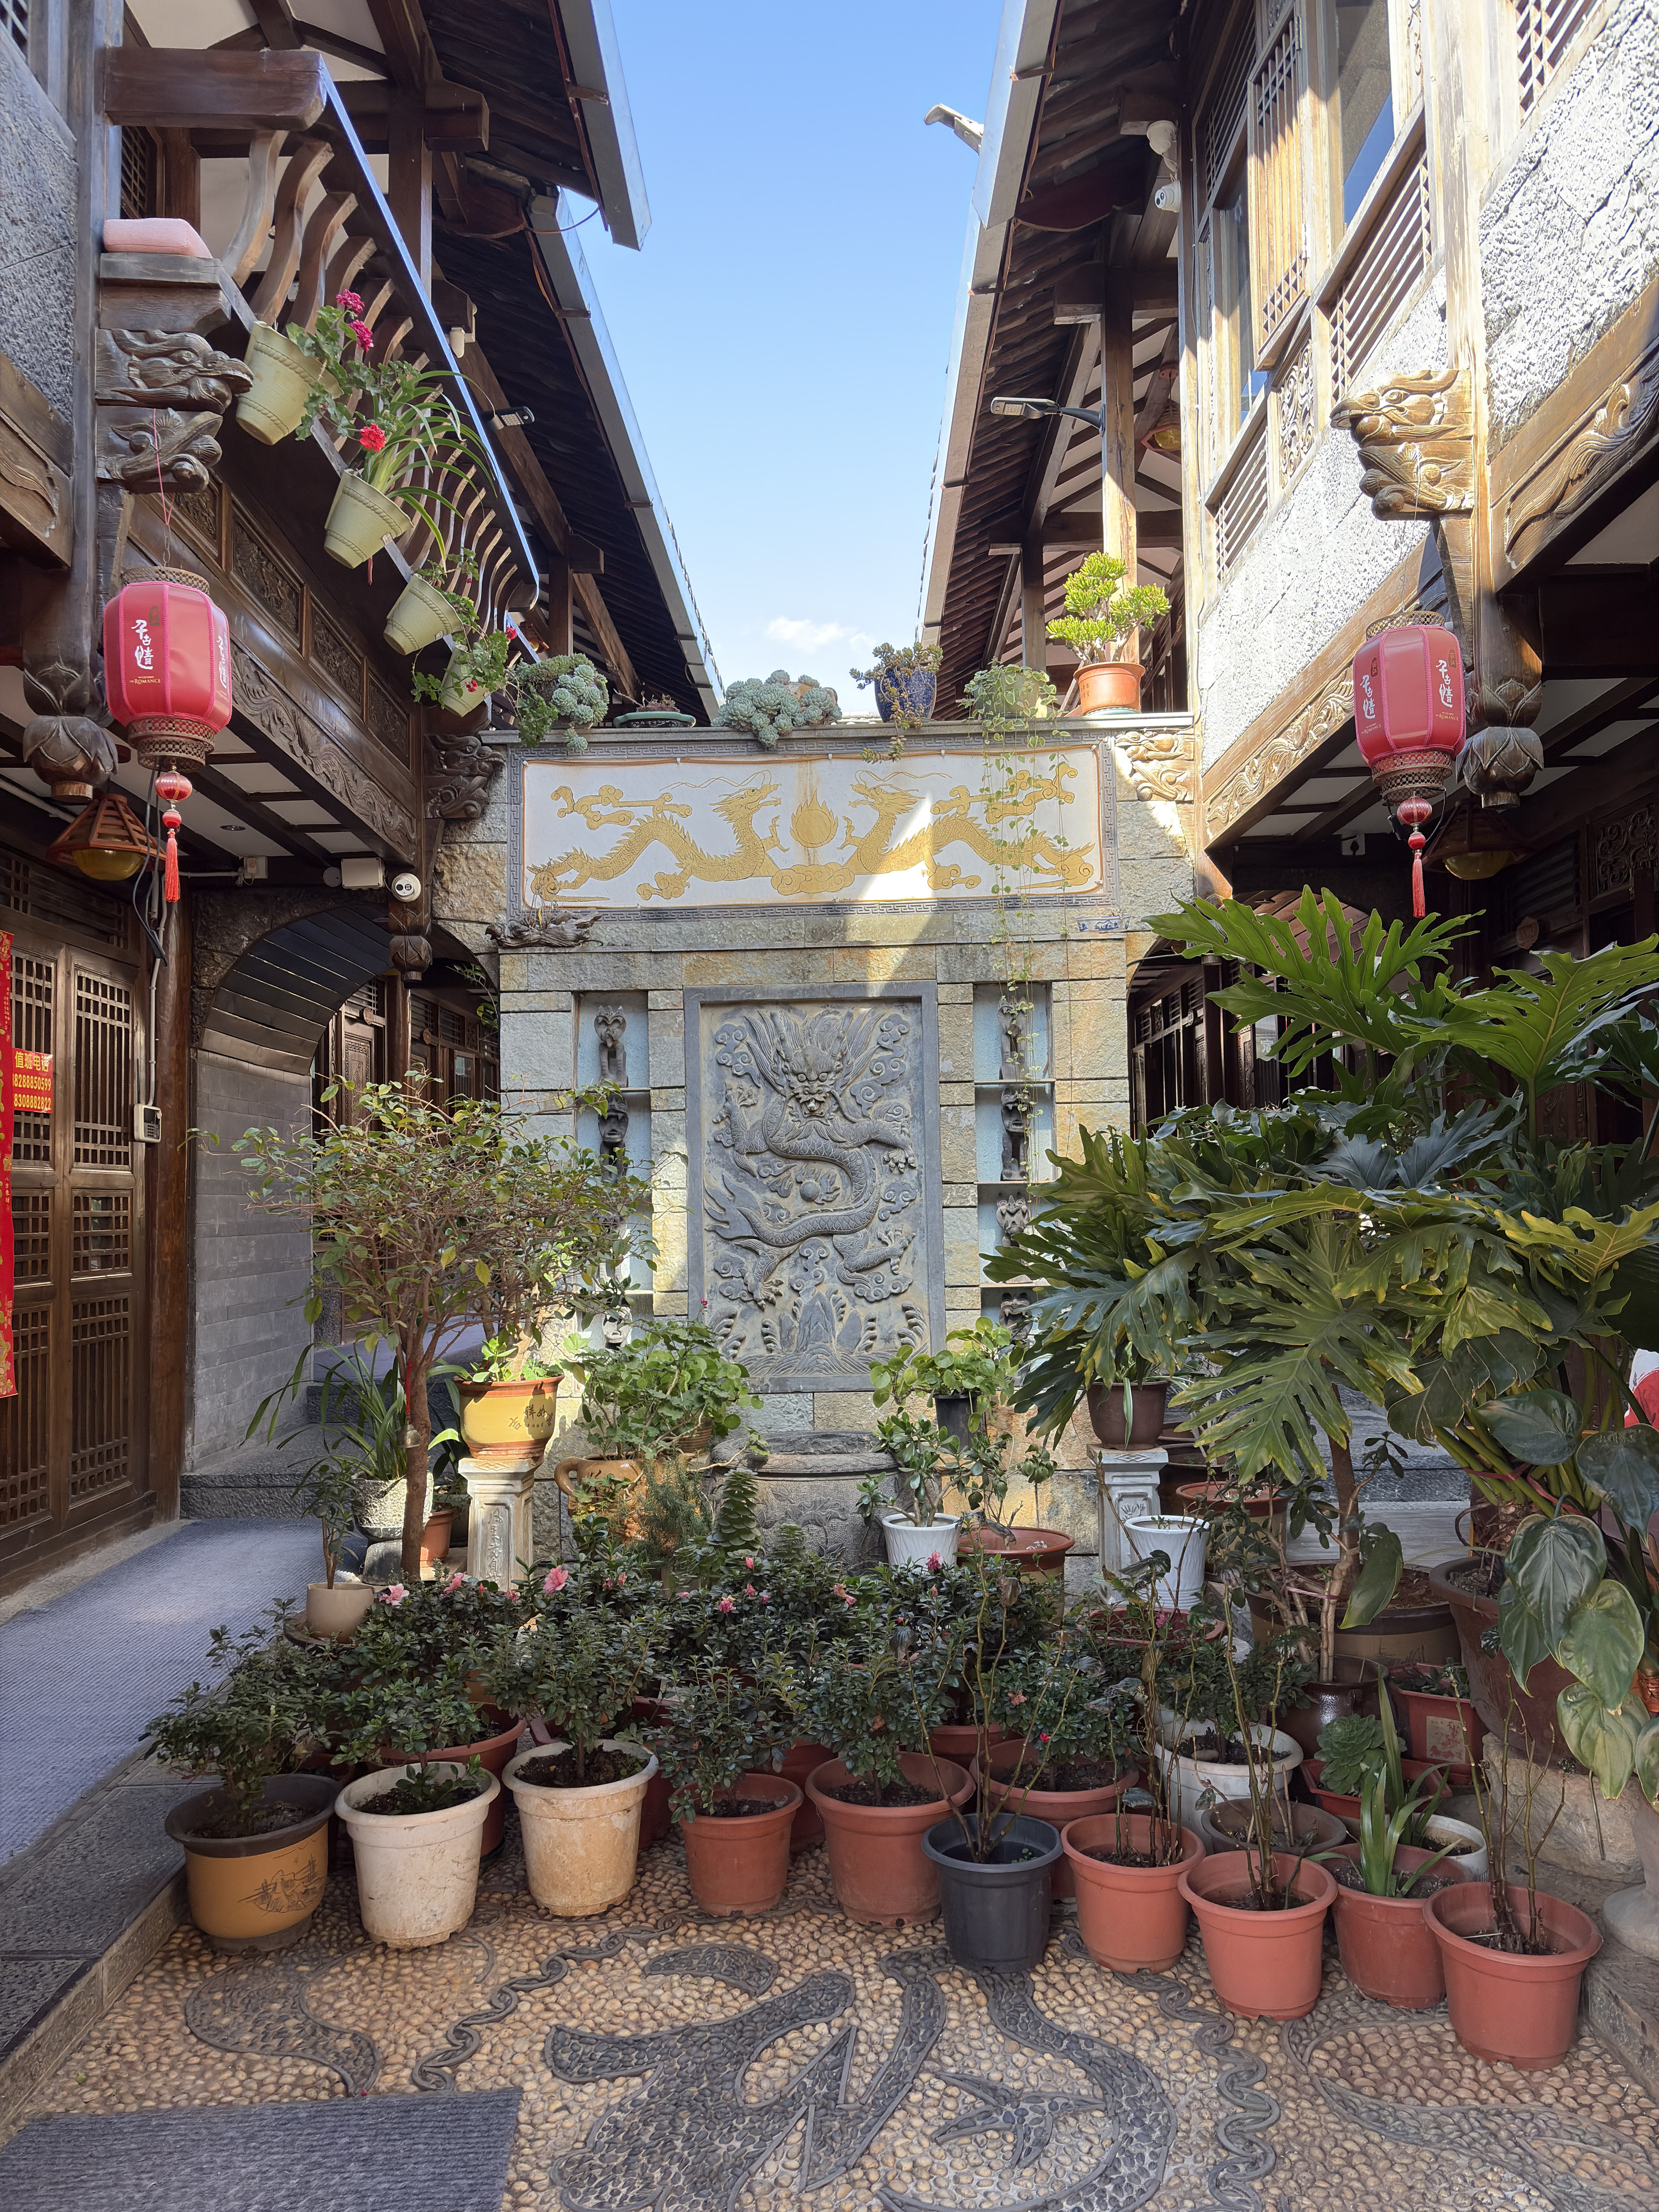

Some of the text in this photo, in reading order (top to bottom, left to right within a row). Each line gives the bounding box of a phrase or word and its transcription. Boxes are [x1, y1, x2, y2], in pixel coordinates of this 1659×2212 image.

[131, 619, 154, 670] 千古情
[1360, 674, 1375, 719] 千古情
[1436, 659, 1453, 708] 千古情
[1364, 724, 1381, 734] ROMANCE
[15, 1051, 49, 1072] 值班电话
[14, 1093, 51, 1110] 8308882822
